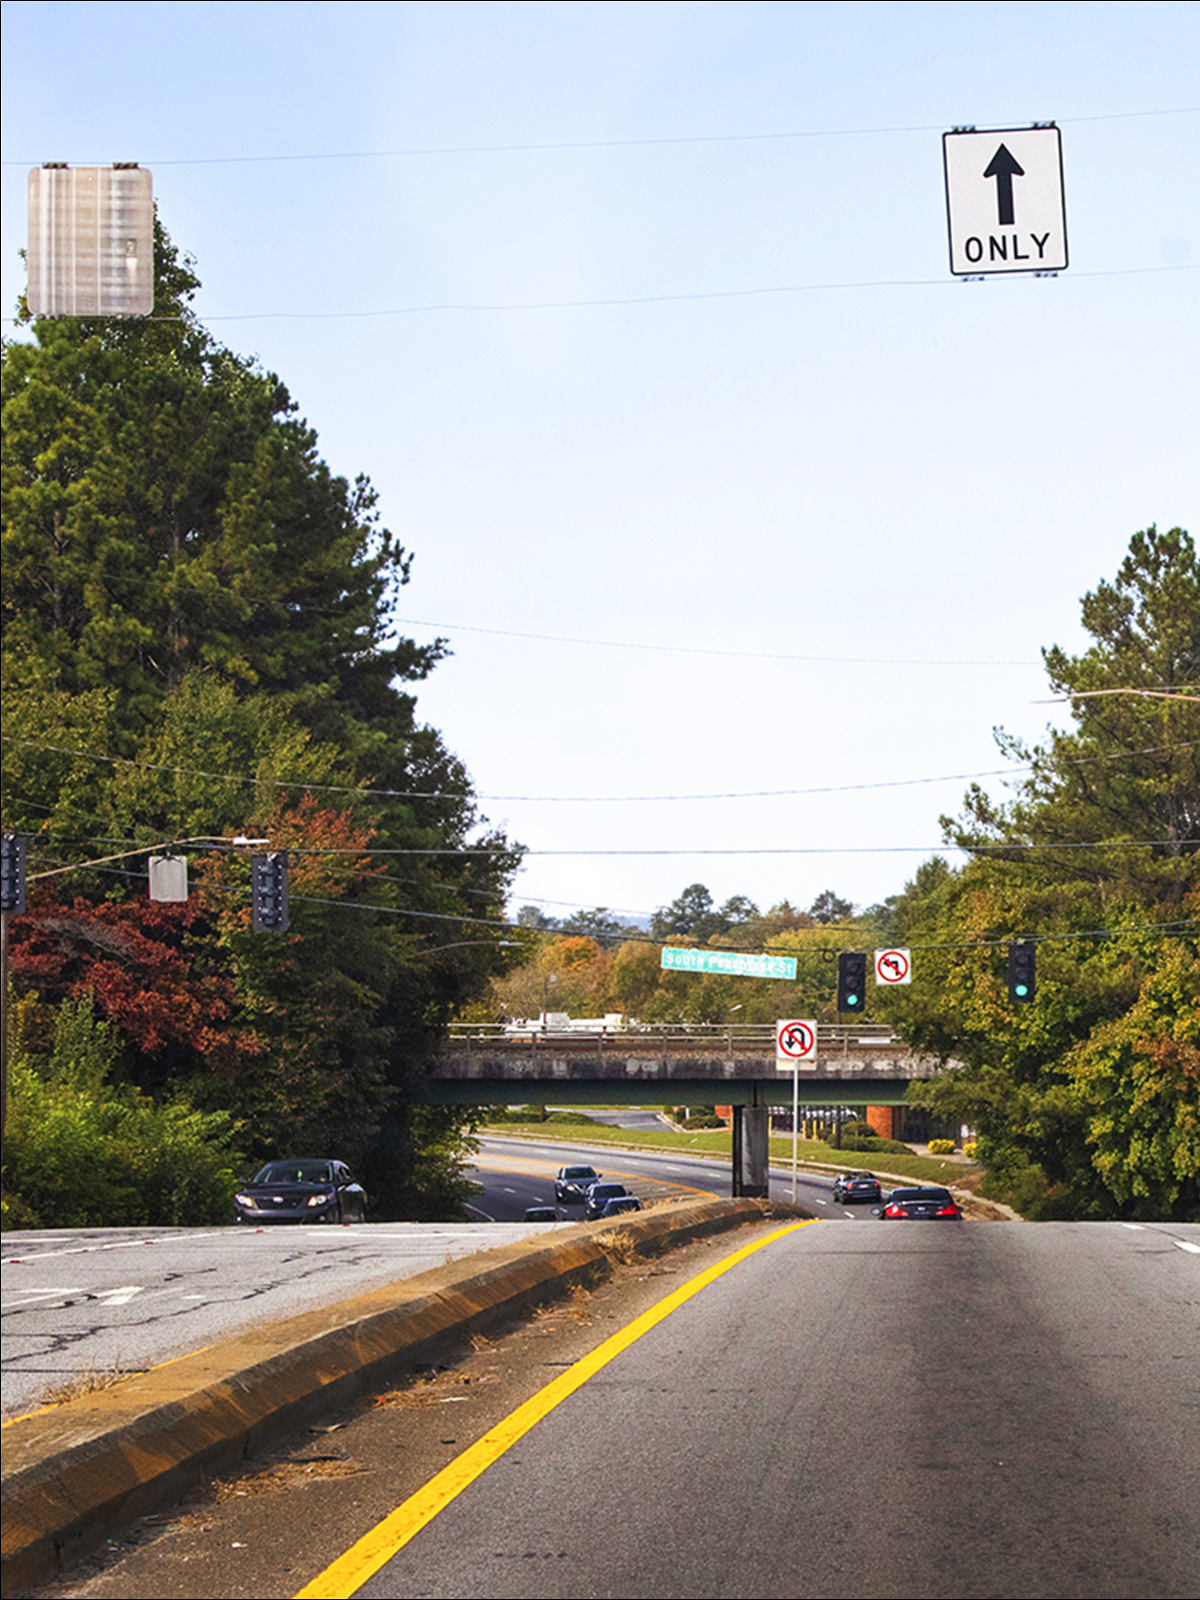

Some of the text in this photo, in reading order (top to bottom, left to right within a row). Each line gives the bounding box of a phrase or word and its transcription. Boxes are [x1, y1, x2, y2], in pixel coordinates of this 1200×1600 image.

[965, 232, 1050, 262] ONLY
[666, 952, 704, 967] South
[778, 960, 793, 974] St
